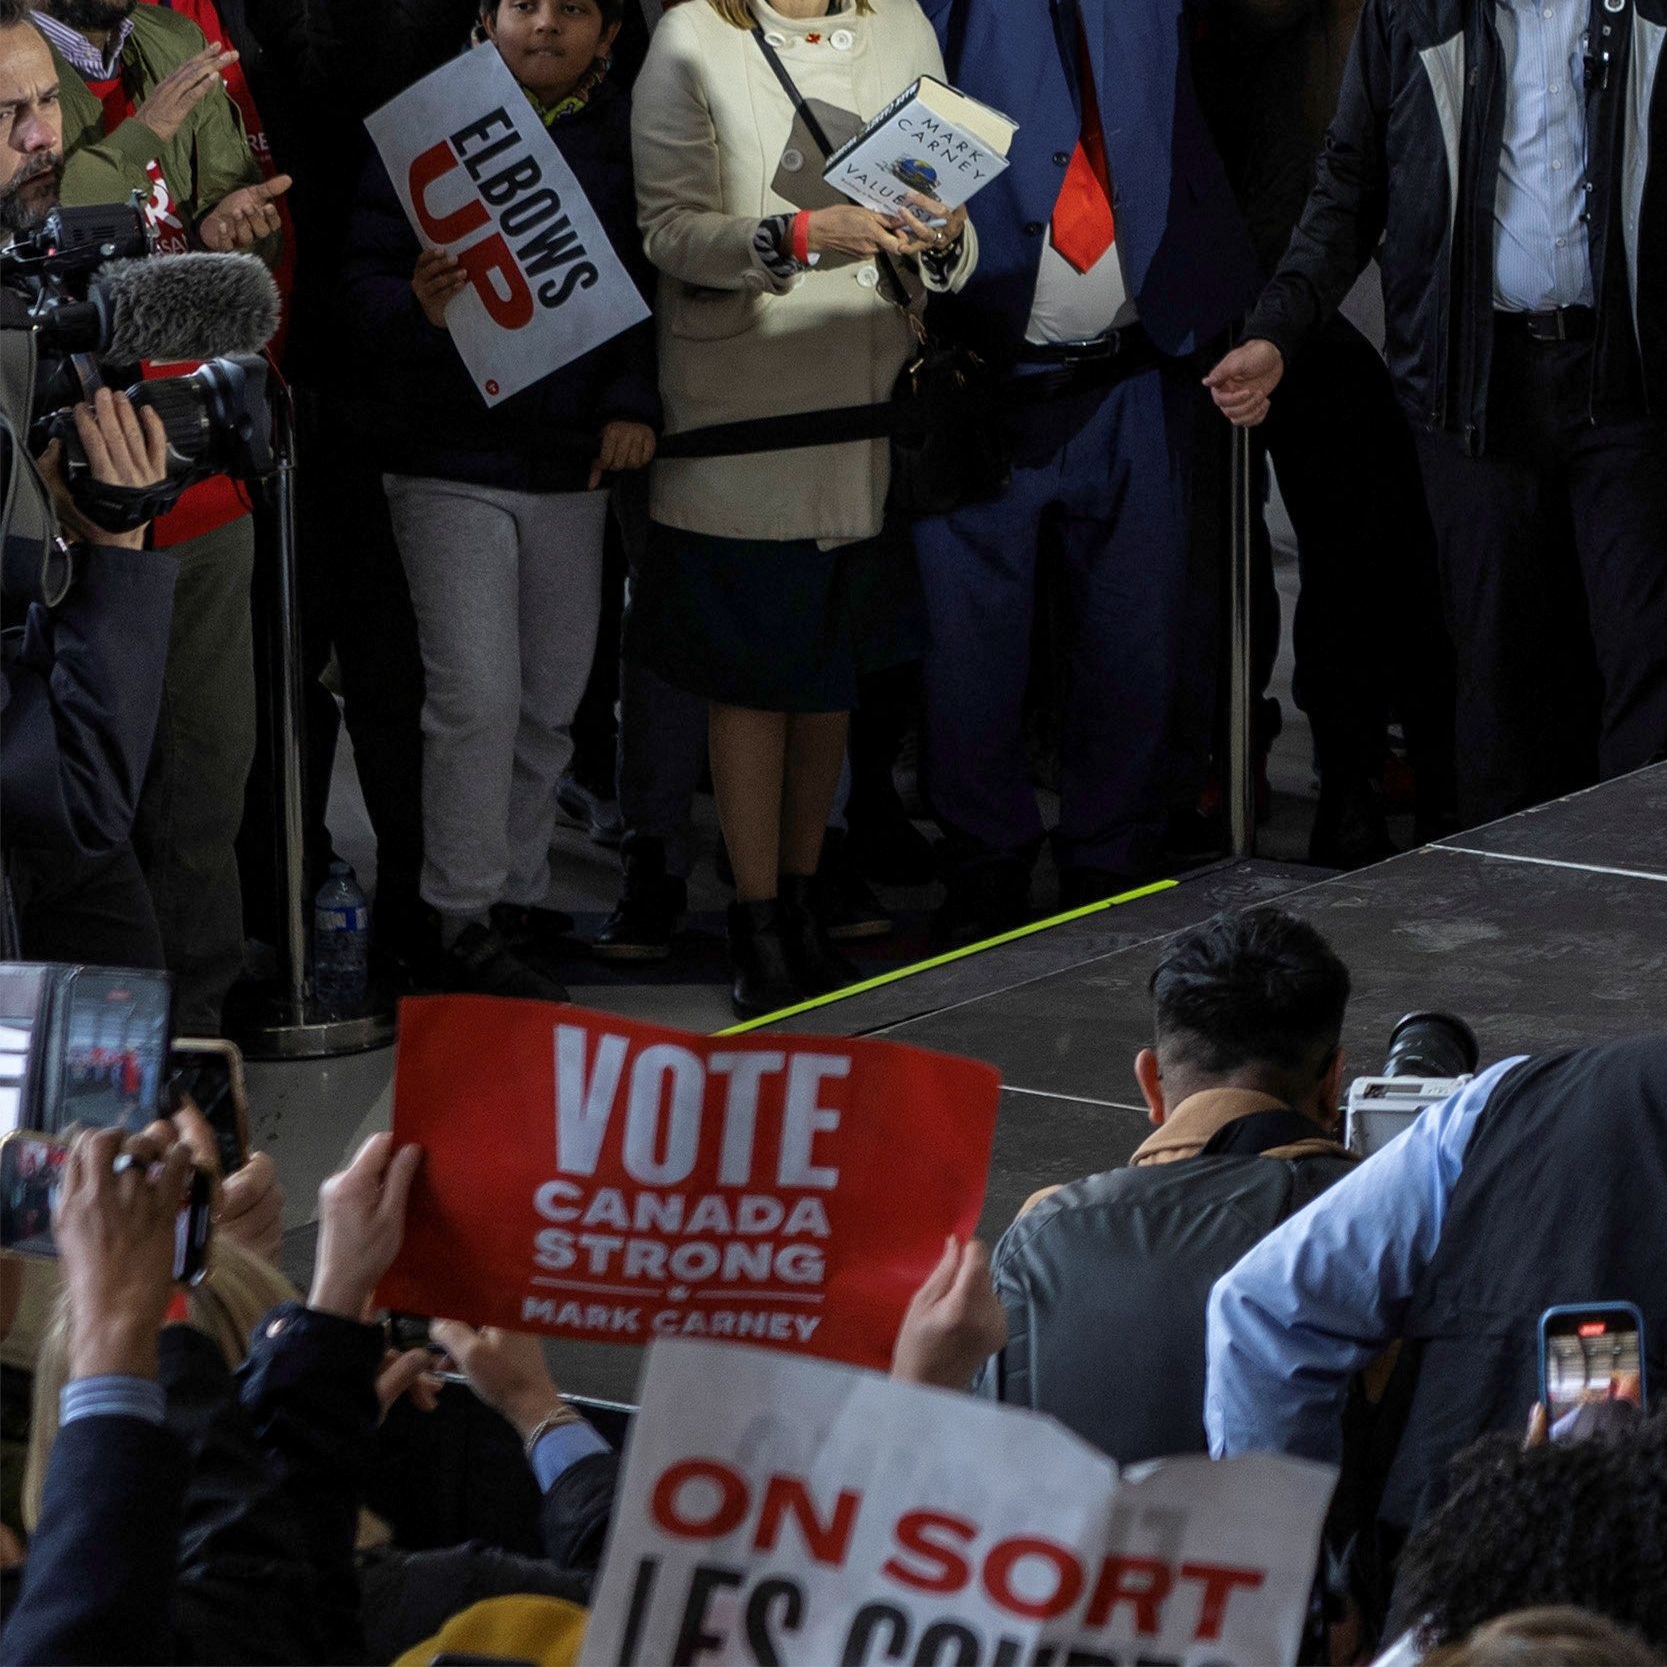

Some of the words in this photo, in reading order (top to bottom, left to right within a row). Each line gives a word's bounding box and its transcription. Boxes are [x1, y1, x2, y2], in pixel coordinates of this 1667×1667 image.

[896, 118, 985, 183] CARNEY
[920, 117, 986, 163] MARK
[408, 140, 536, 331] UP
[450, 106, 601, 310] ELBOWS
[552, 1023, 851, 1190] VOTE
[533, 1180, 831, 1240] CANADA
[533, 1229, 826, 1285] STRONG
[520, 1295, 640, 1332] MARK
[651, 1308, 823, 1345] CARNEY
[651, 1458, 860, 1566] ON
[883, 1508, 1267, 1641] SORT
